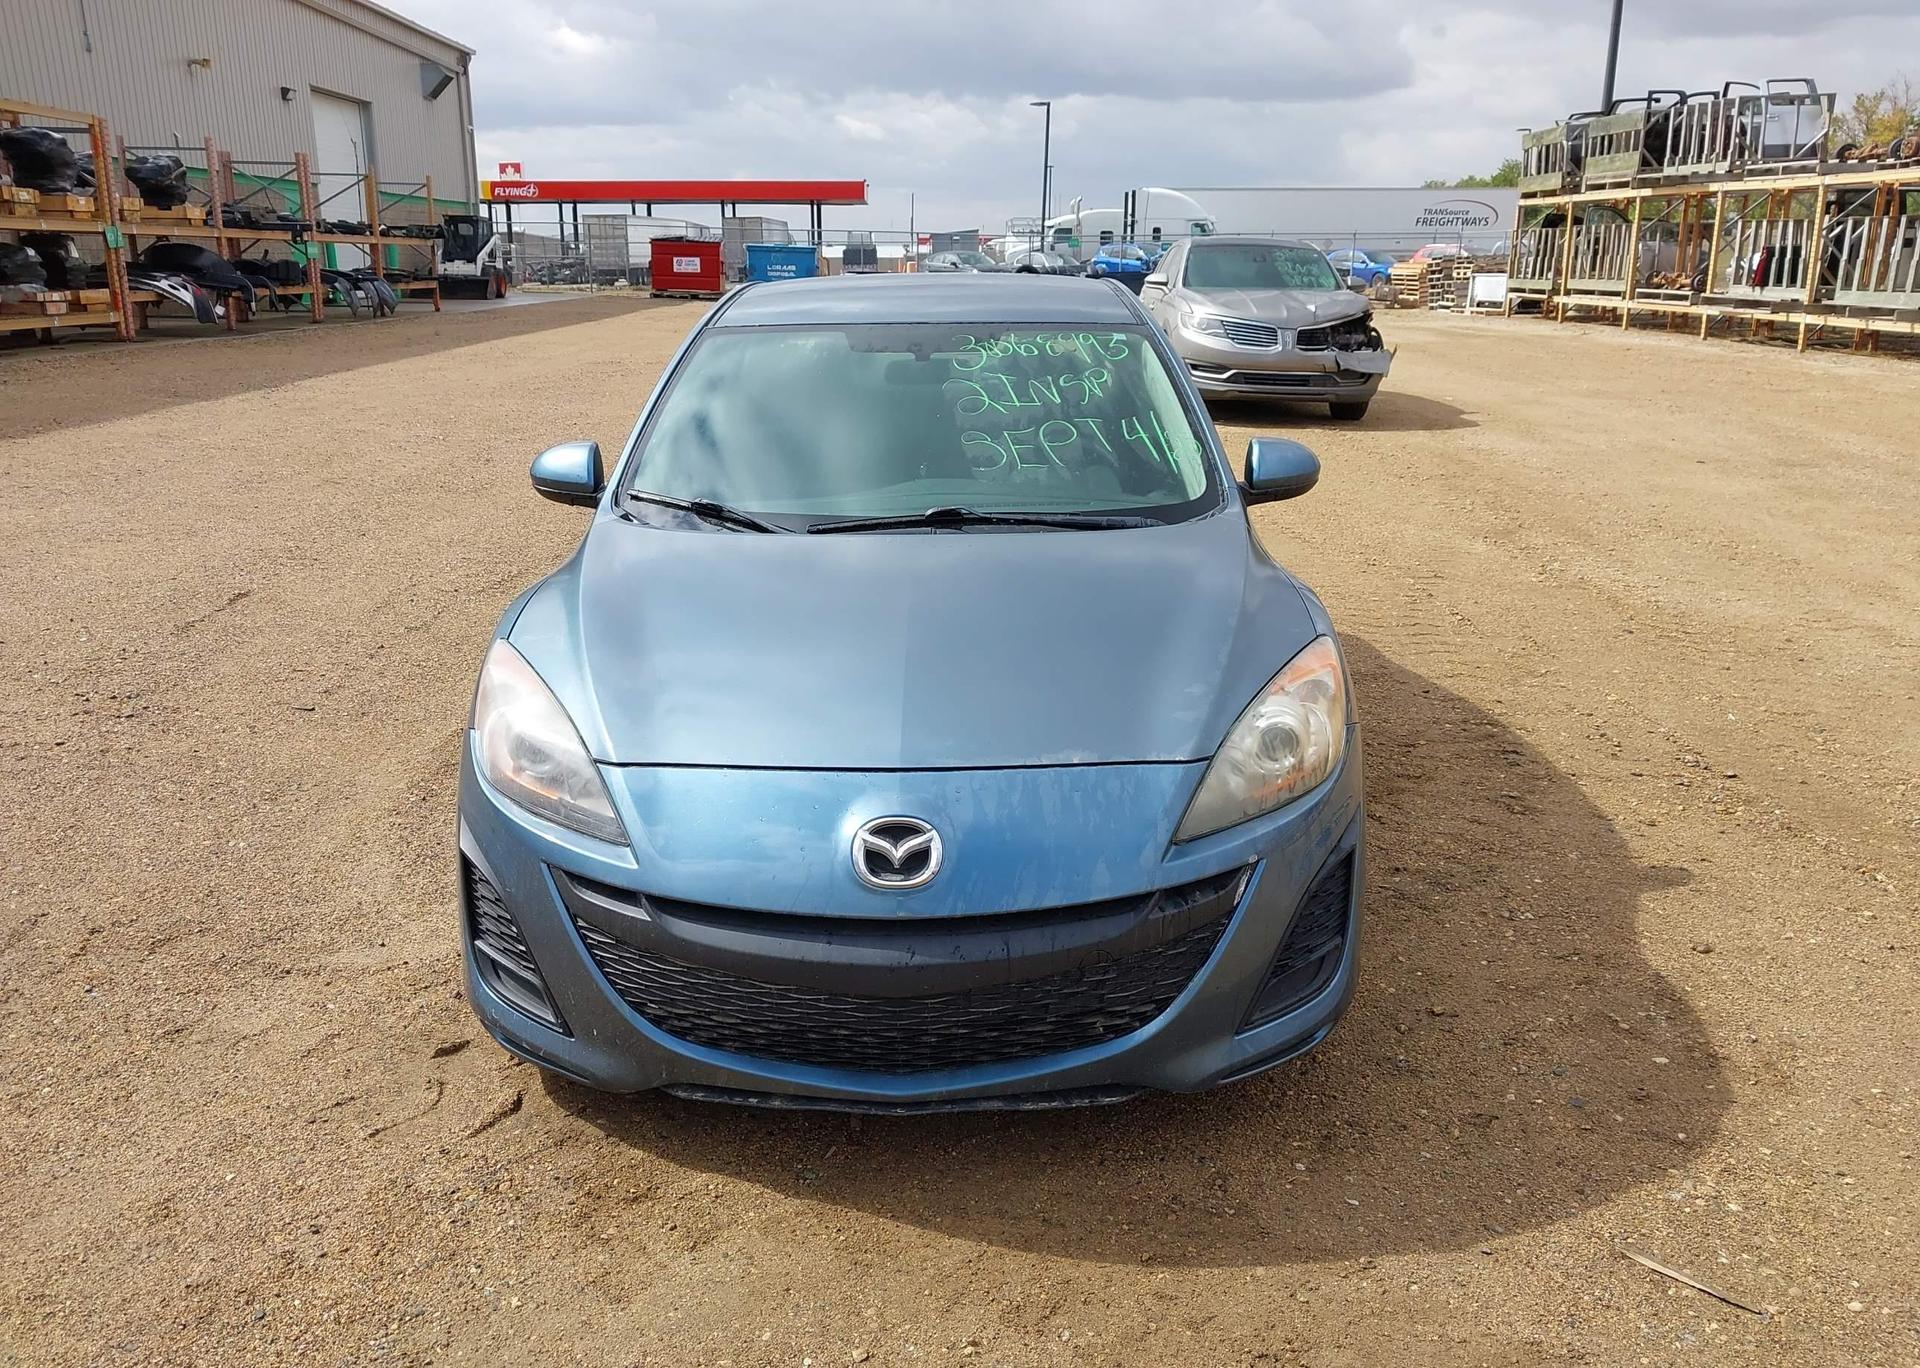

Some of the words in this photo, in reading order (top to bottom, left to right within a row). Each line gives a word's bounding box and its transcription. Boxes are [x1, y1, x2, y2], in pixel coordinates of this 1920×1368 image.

[494, 187, 527, 196] FLYING
[1423, 208, 1470, 216] TRANSource
[1415, 217, 1489, 227] FREIGHTWAYS
[960, 418, 1113, 472] SEPT
